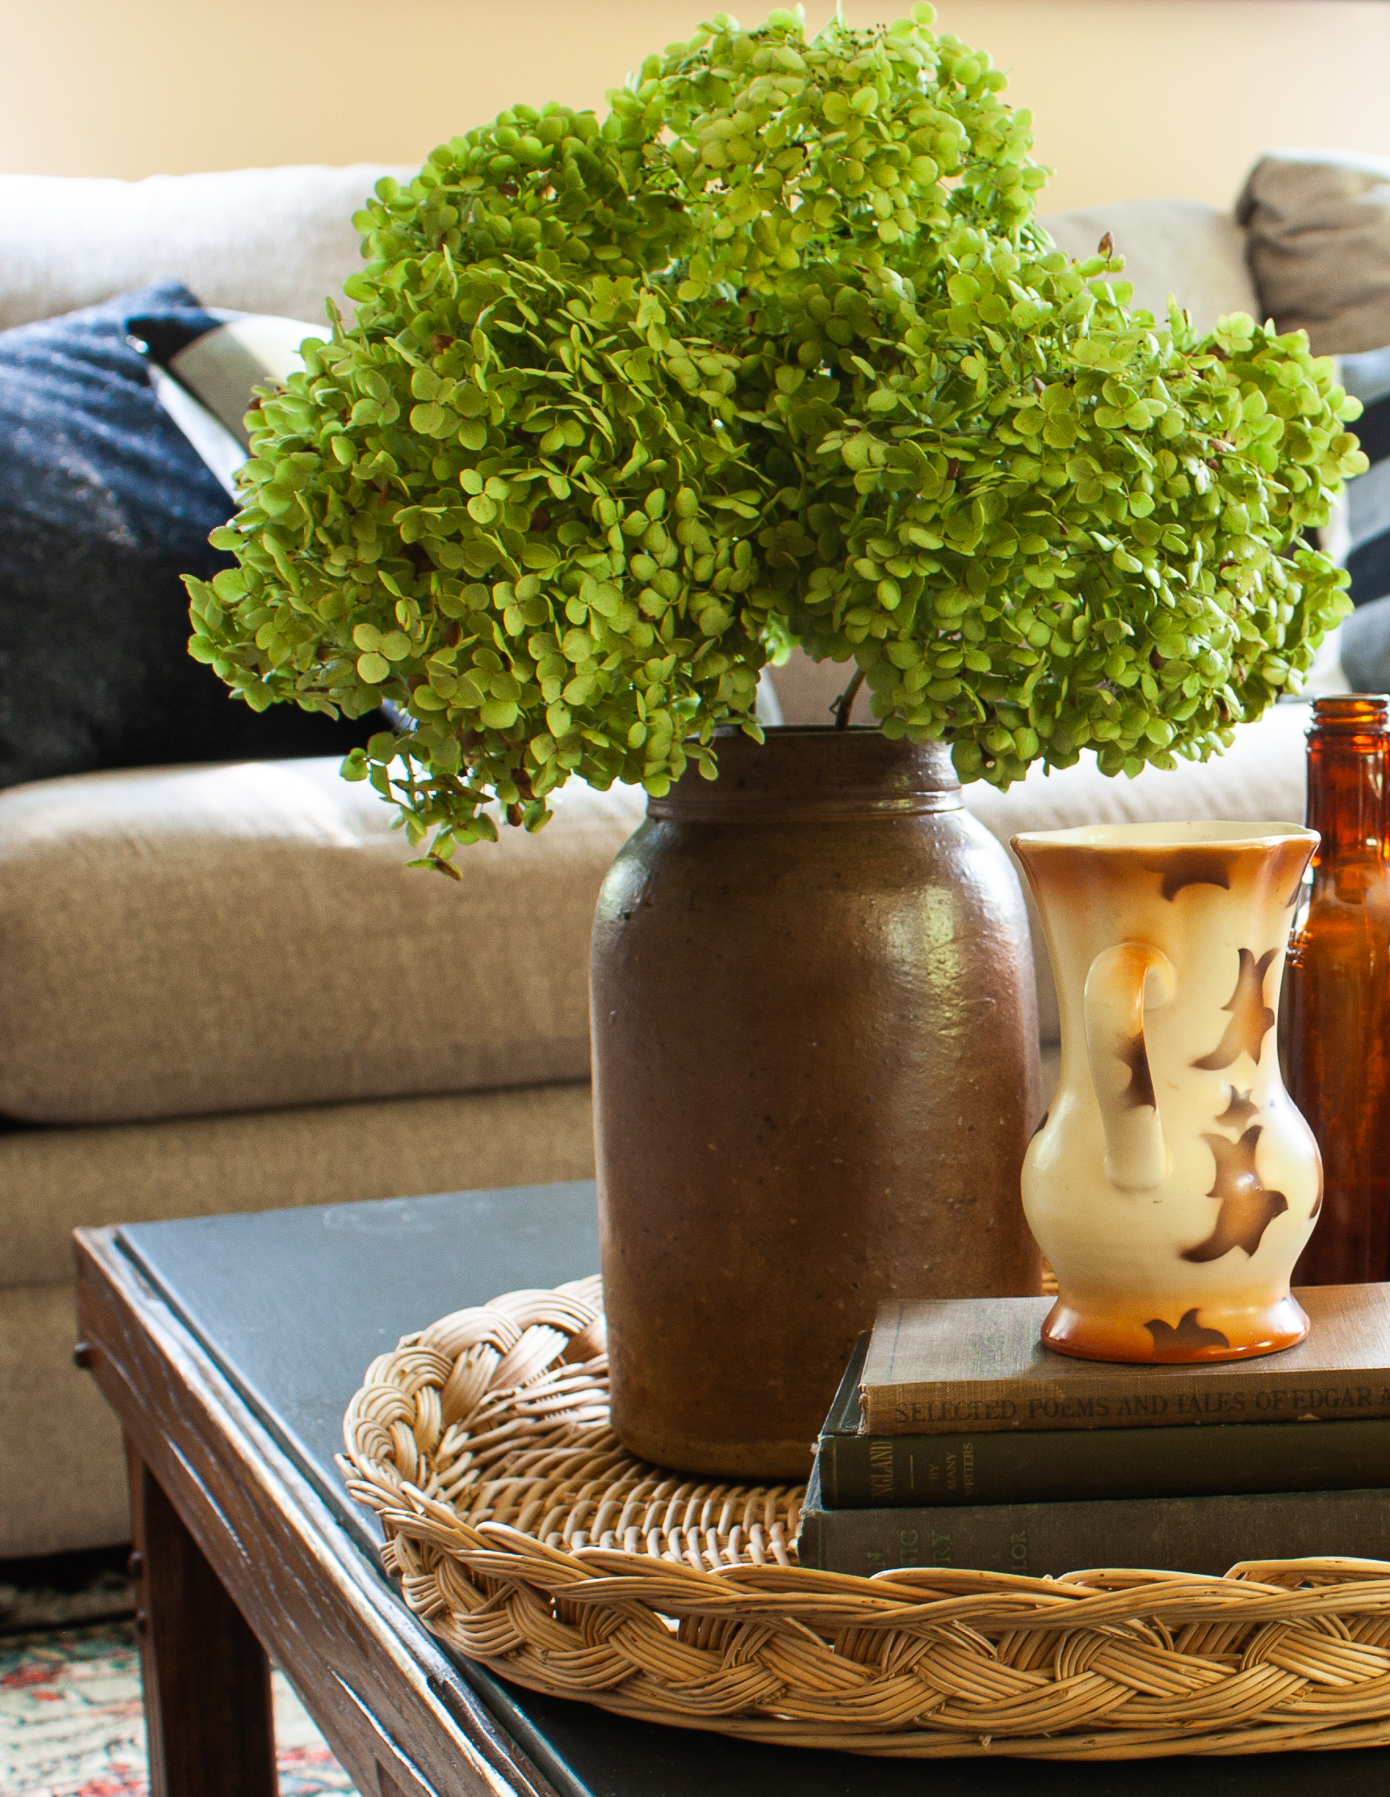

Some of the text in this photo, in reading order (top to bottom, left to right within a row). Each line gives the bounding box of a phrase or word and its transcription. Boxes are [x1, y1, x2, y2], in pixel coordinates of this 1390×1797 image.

[895, 1399, 1016, 1424] SELECTED
[1028, 1396, 1111, 1420] POEMS
[1117, 1394, 1169, 1417] AND
[1175, 1391, 1246, 1414] TALES
[1255, 1389, 1288, 1411] OF
[1290, 1385, 1372, 1410] EDGAR
[869, 1440, 894, 1500] NGLAND
[928, 1463, 940, 1480] BY
[946, 1451, 957, 1490] MANY
[963, 1442, 974, 1498] WRITERS
[931, 1530, 950, 1566] RY
[1010, 1530, 1027, 1572] LOR
